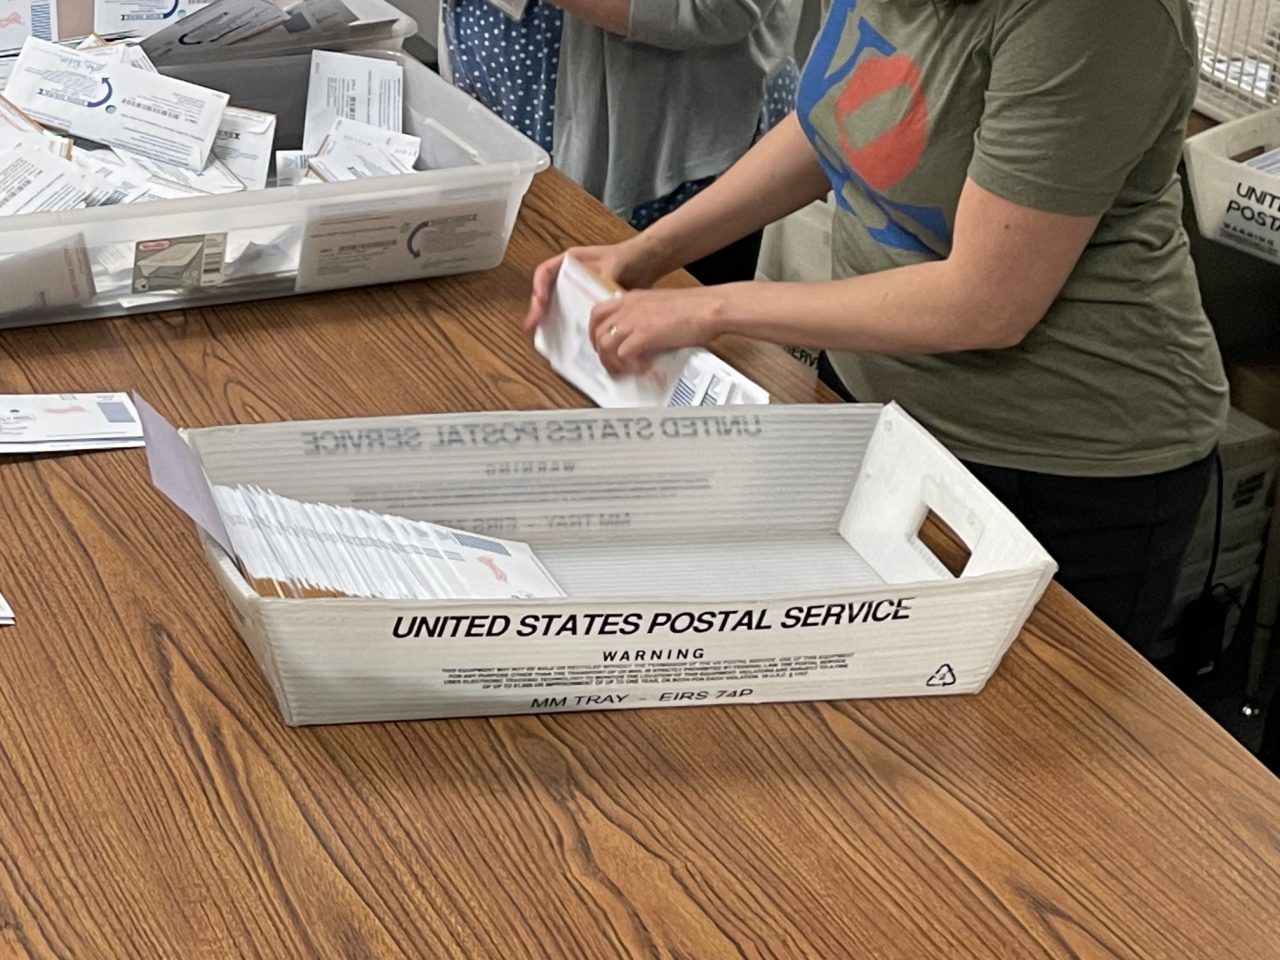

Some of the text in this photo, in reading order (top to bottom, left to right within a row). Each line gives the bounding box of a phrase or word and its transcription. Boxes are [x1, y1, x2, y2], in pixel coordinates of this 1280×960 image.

[1236, 182, 1280, 213] UNIT
[392, 596, 918, 639] UNITED STATES POSTAL SERVICE
[603, 648, 705, 662] WARNING
[530, 697, 568, 709] MM
[574, 693, 630, 706] TRAY
[658, 690, 710, 702] EIRS
[714, 688, 754, 699] 74P
